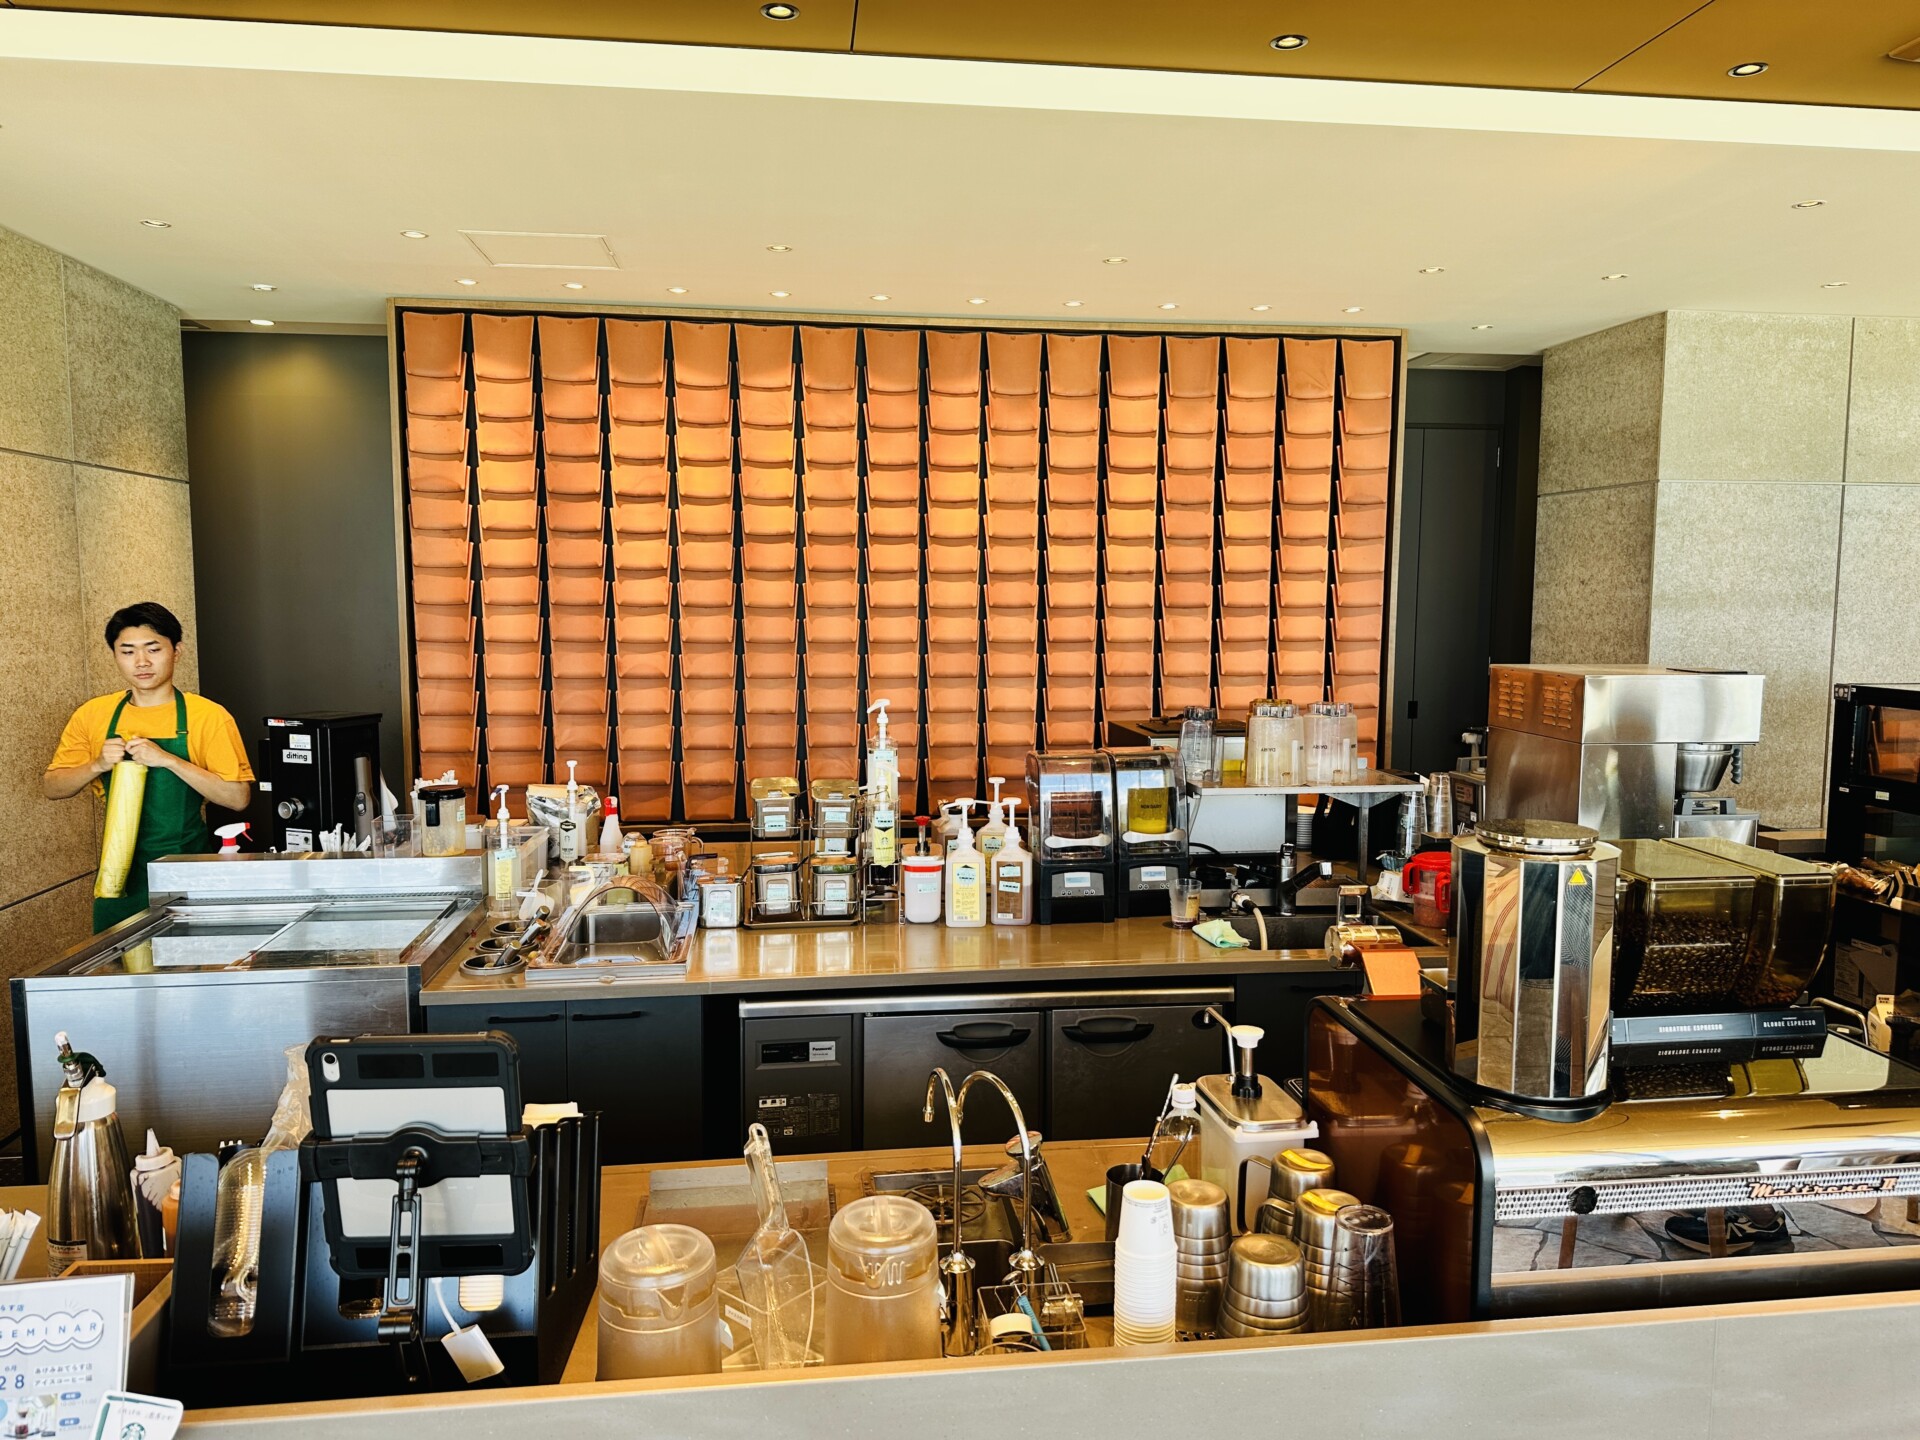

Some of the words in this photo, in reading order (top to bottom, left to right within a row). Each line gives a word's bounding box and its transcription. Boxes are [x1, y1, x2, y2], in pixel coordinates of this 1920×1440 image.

[286, 752, 308, 761] ditting
[1787, 1019, 1816, 1027] ESPRESSO
[1658, 1025, 1691, 1033] SIGNATURE
[1693, 1023, 1723, 1031] ESPRESSO
